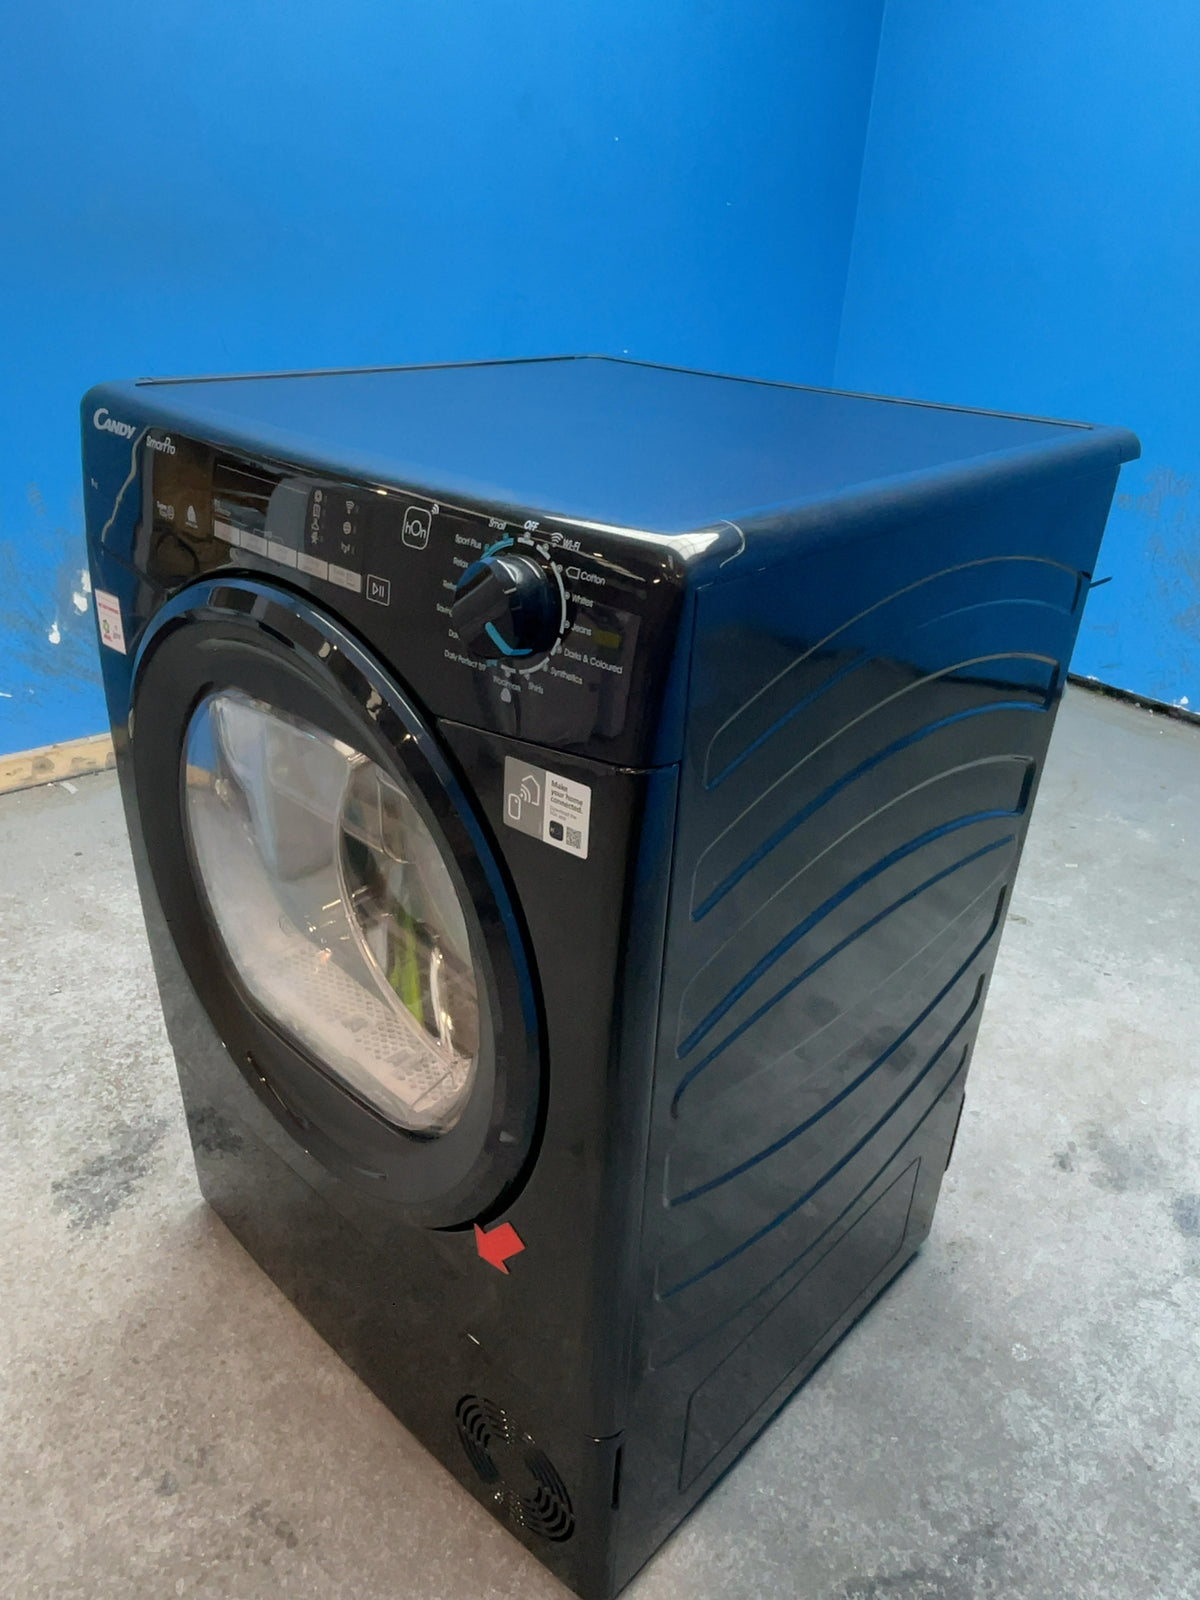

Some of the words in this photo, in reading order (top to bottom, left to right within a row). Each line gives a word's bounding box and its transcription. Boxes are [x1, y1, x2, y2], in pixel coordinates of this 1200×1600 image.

[405, 519, 427, 540] hOn
[524, 520, 540, 531] OFF
[580, 571, 606, 586] Cotton
[571, 594, 594, 608] Whites
[571, 623, 592, 637] Jeans
[583, 654, 589, 663] &
[589, 656, 623, 675] Coloured
[550, 666, 583, 685] Synthetics
[551, 780, 568, 792] Make
